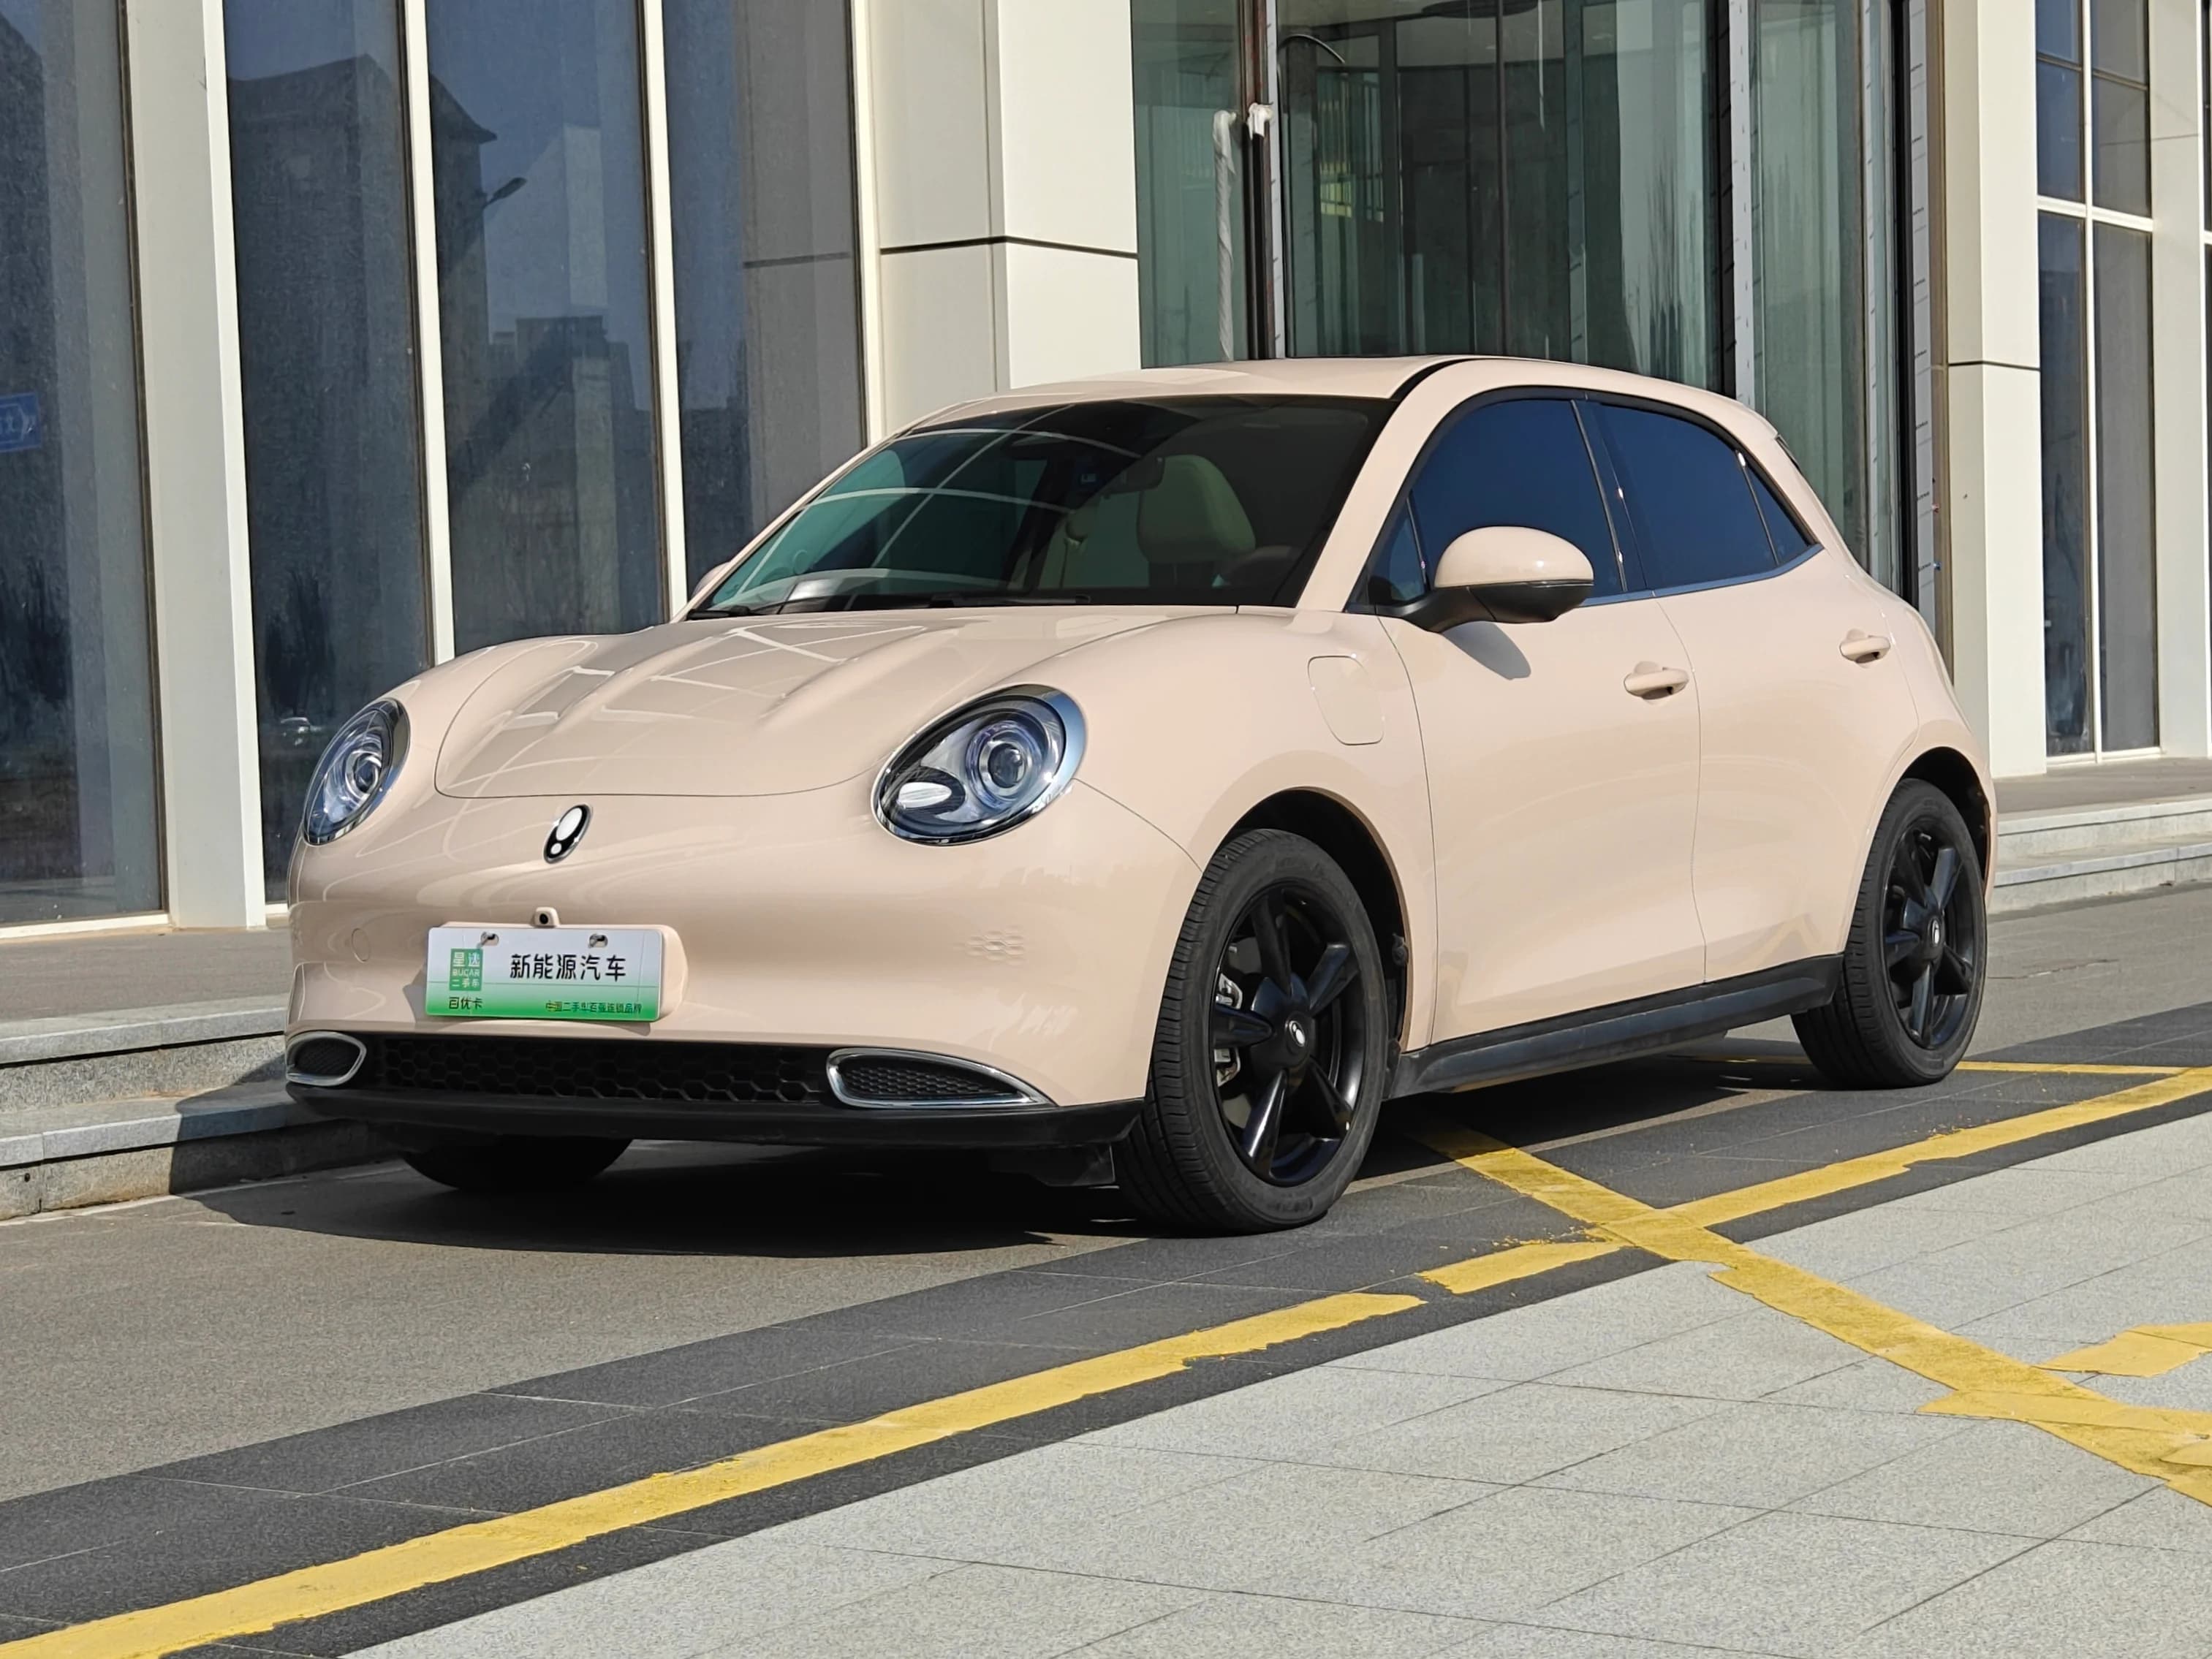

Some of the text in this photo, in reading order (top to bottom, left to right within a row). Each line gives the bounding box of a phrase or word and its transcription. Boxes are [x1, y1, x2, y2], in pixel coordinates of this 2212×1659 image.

[452, 968, 480, 976] BUCAR
[510, 953, 626, 982] 新能源汽车
[449, 996, 483, 1009] 百优卡
